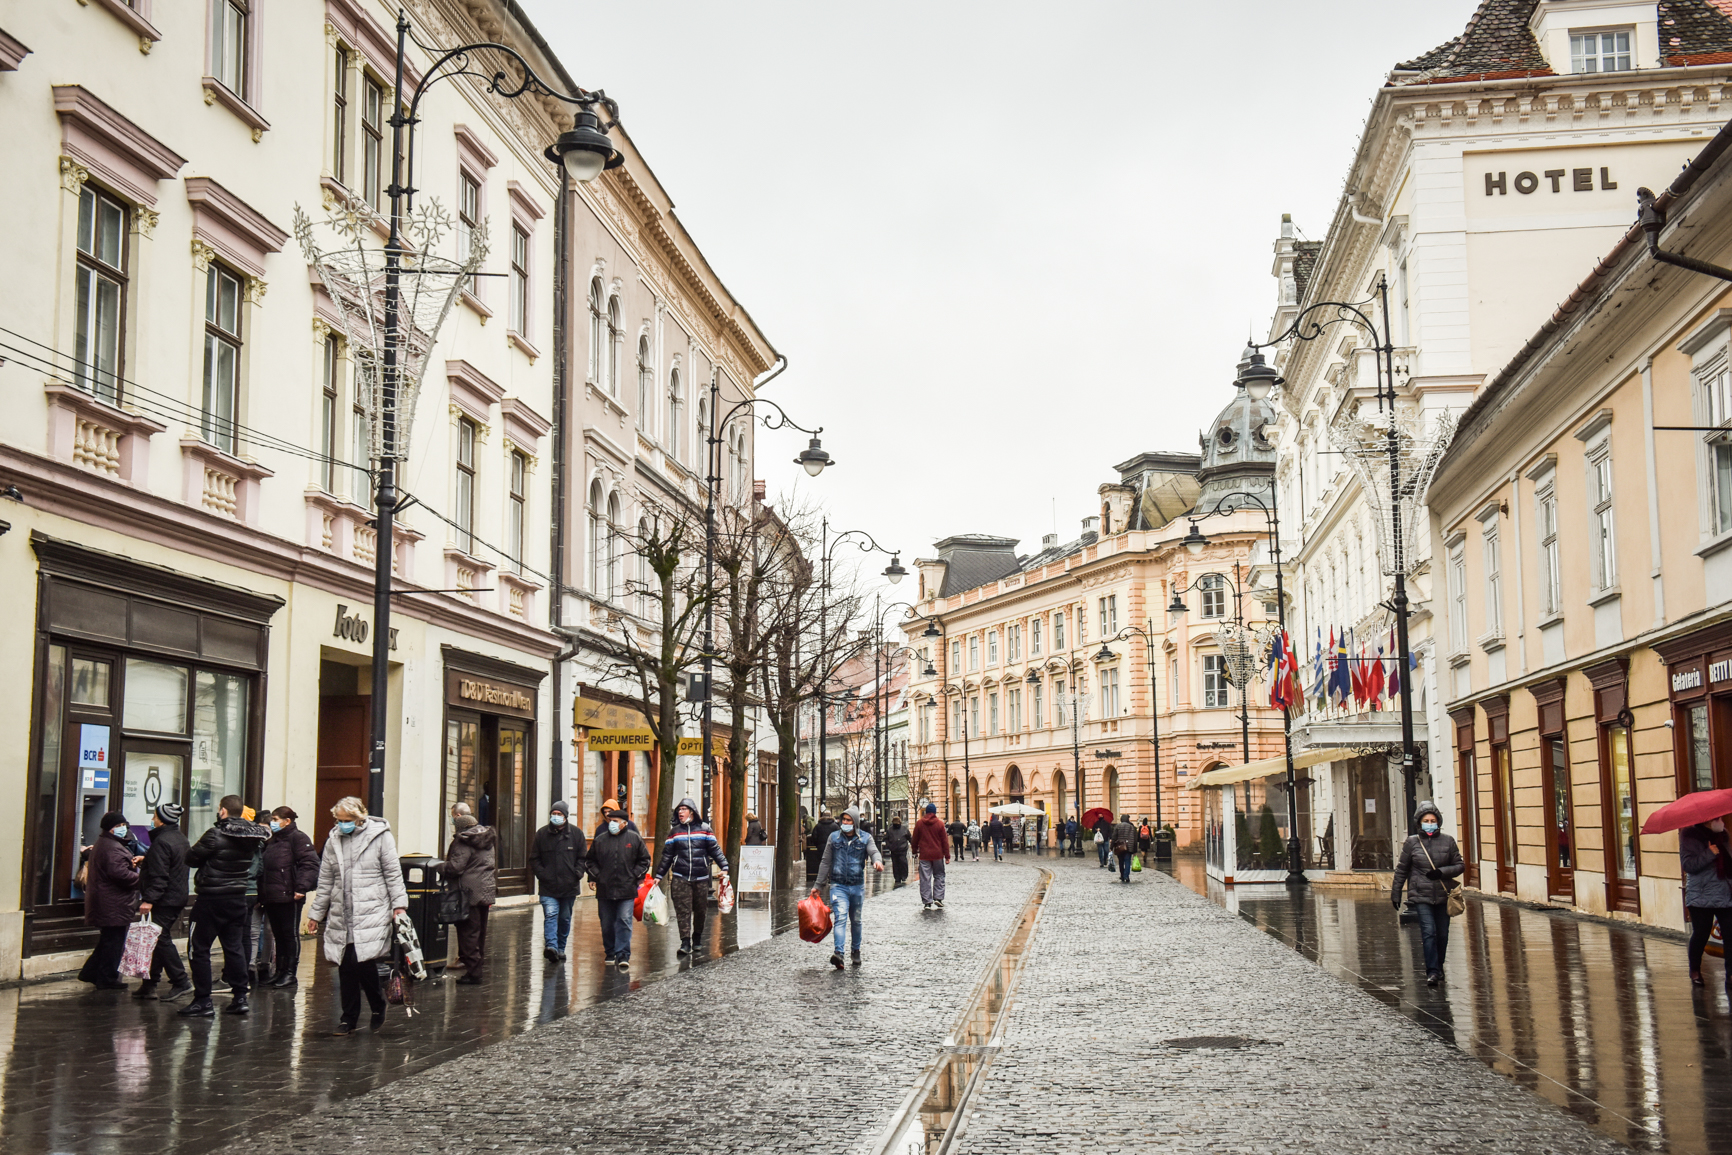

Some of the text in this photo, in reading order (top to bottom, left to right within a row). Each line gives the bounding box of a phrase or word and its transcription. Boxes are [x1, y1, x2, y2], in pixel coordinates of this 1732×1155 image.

[1484, 166, 1618, 196] HOTEL
[333, 603, 369, 643] Foto
[1672, 667, 1701, 692] Gelateria
[1709, 660, 1728, 683] BETTY
[590, 734, 650, 745] PARFUMERIE
[680, 742, 715, 751] OPTIA
[83, 749, 97, 761] BCR
